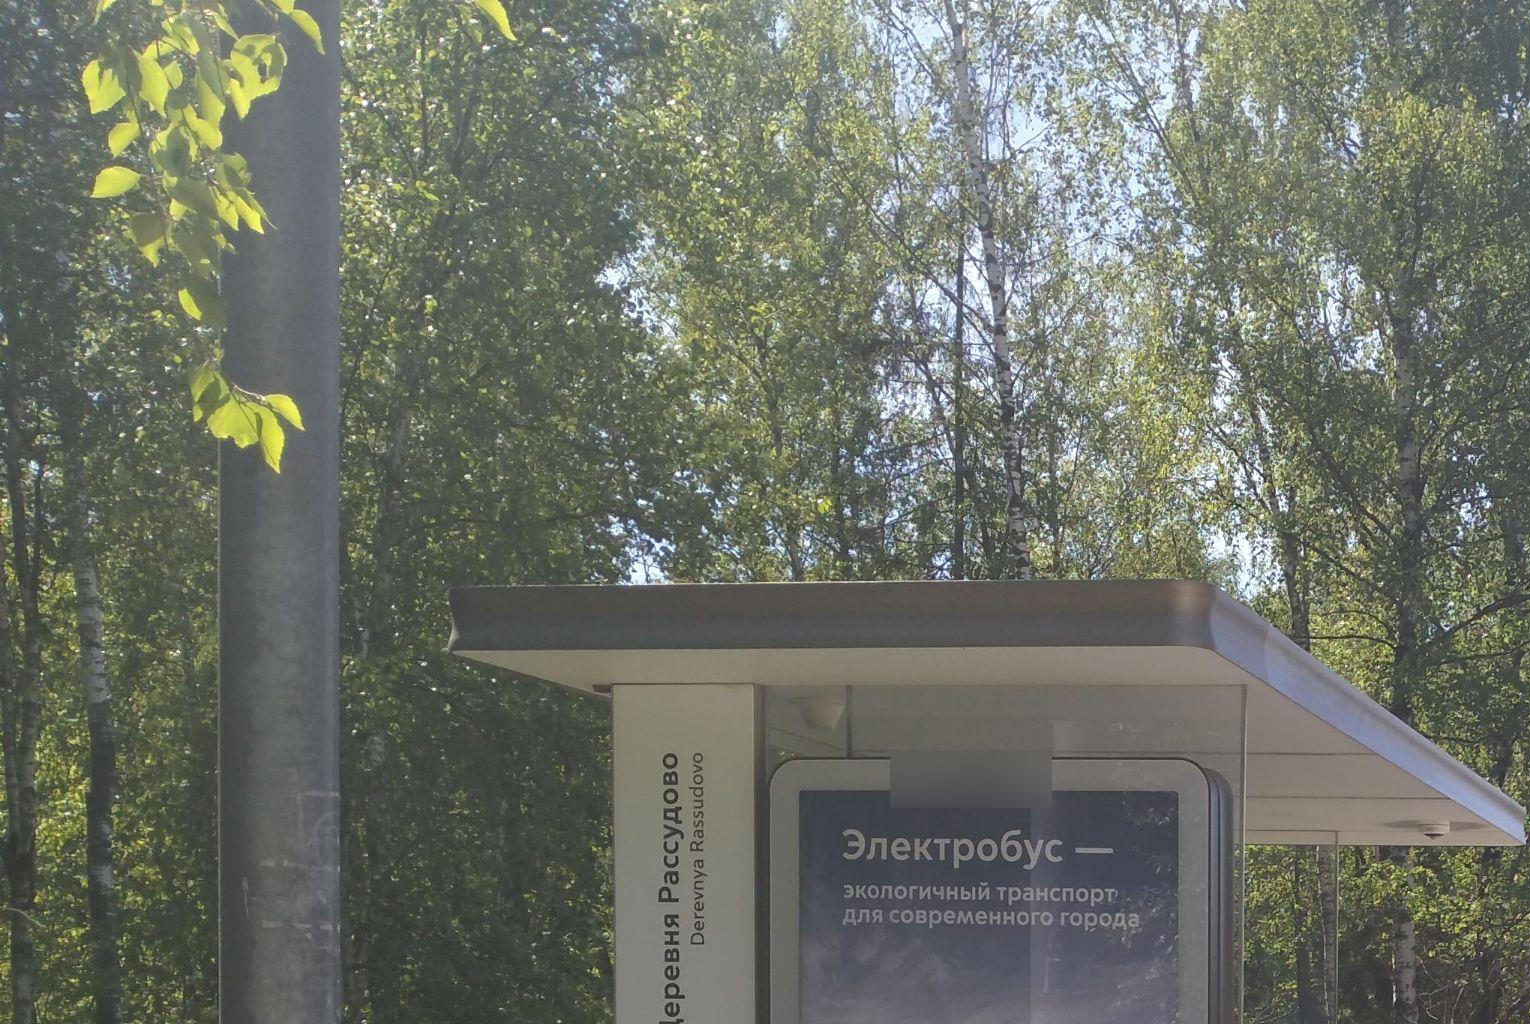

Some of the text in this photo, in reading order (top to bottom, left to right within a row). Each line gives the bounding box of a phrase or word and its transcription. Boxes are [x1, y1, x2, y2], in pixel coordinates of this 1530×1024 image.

[658, 752, 684, 903] Рассудово
[689, 751, 708, 946] Derevnya Rassudovo
[842, 828, 1064, 871] Электробус
[842, 881, 1115, 905] экологичный транспорт
[842, 909, 1141, 932] для современного города
